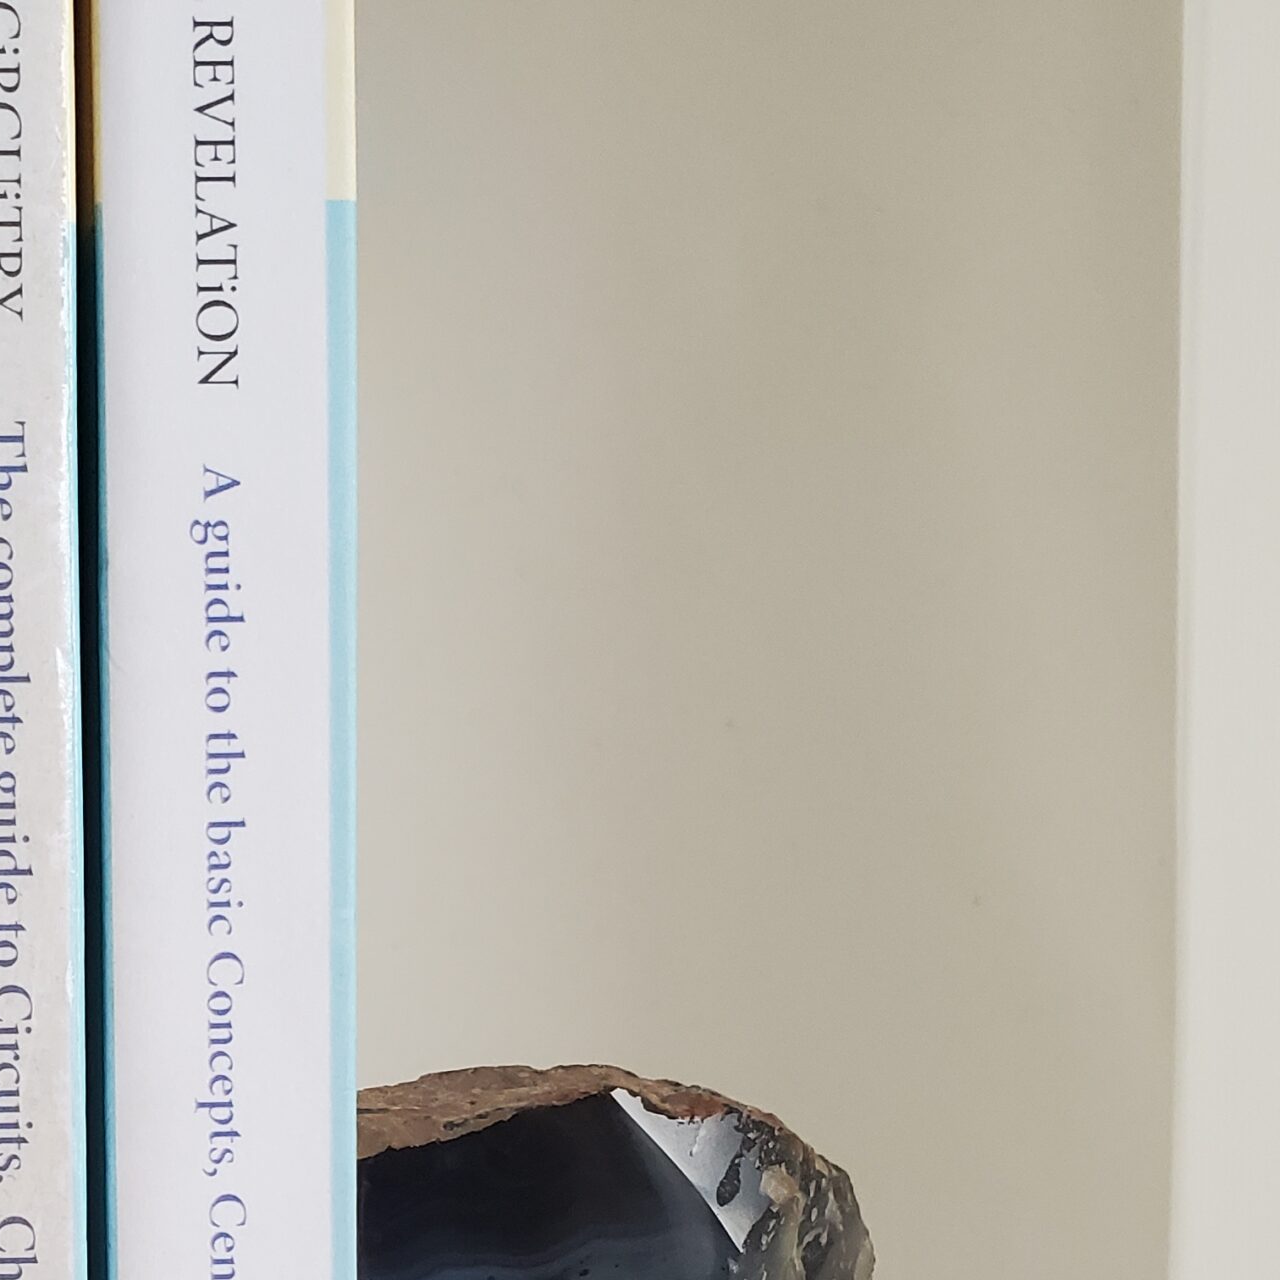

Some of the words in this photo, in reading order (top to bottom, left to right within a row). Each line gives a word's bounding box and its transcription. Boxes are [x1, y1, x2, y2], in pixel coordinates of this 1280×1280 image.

[203, 464, 241, 501] A
[189, 519, 246, 652] guide
[205, 669, 239, 714] to
[205, 730, 246, 804] the
[206, 817, 247, 935] basic
[195, 951, 245, 1177] Concepts,
